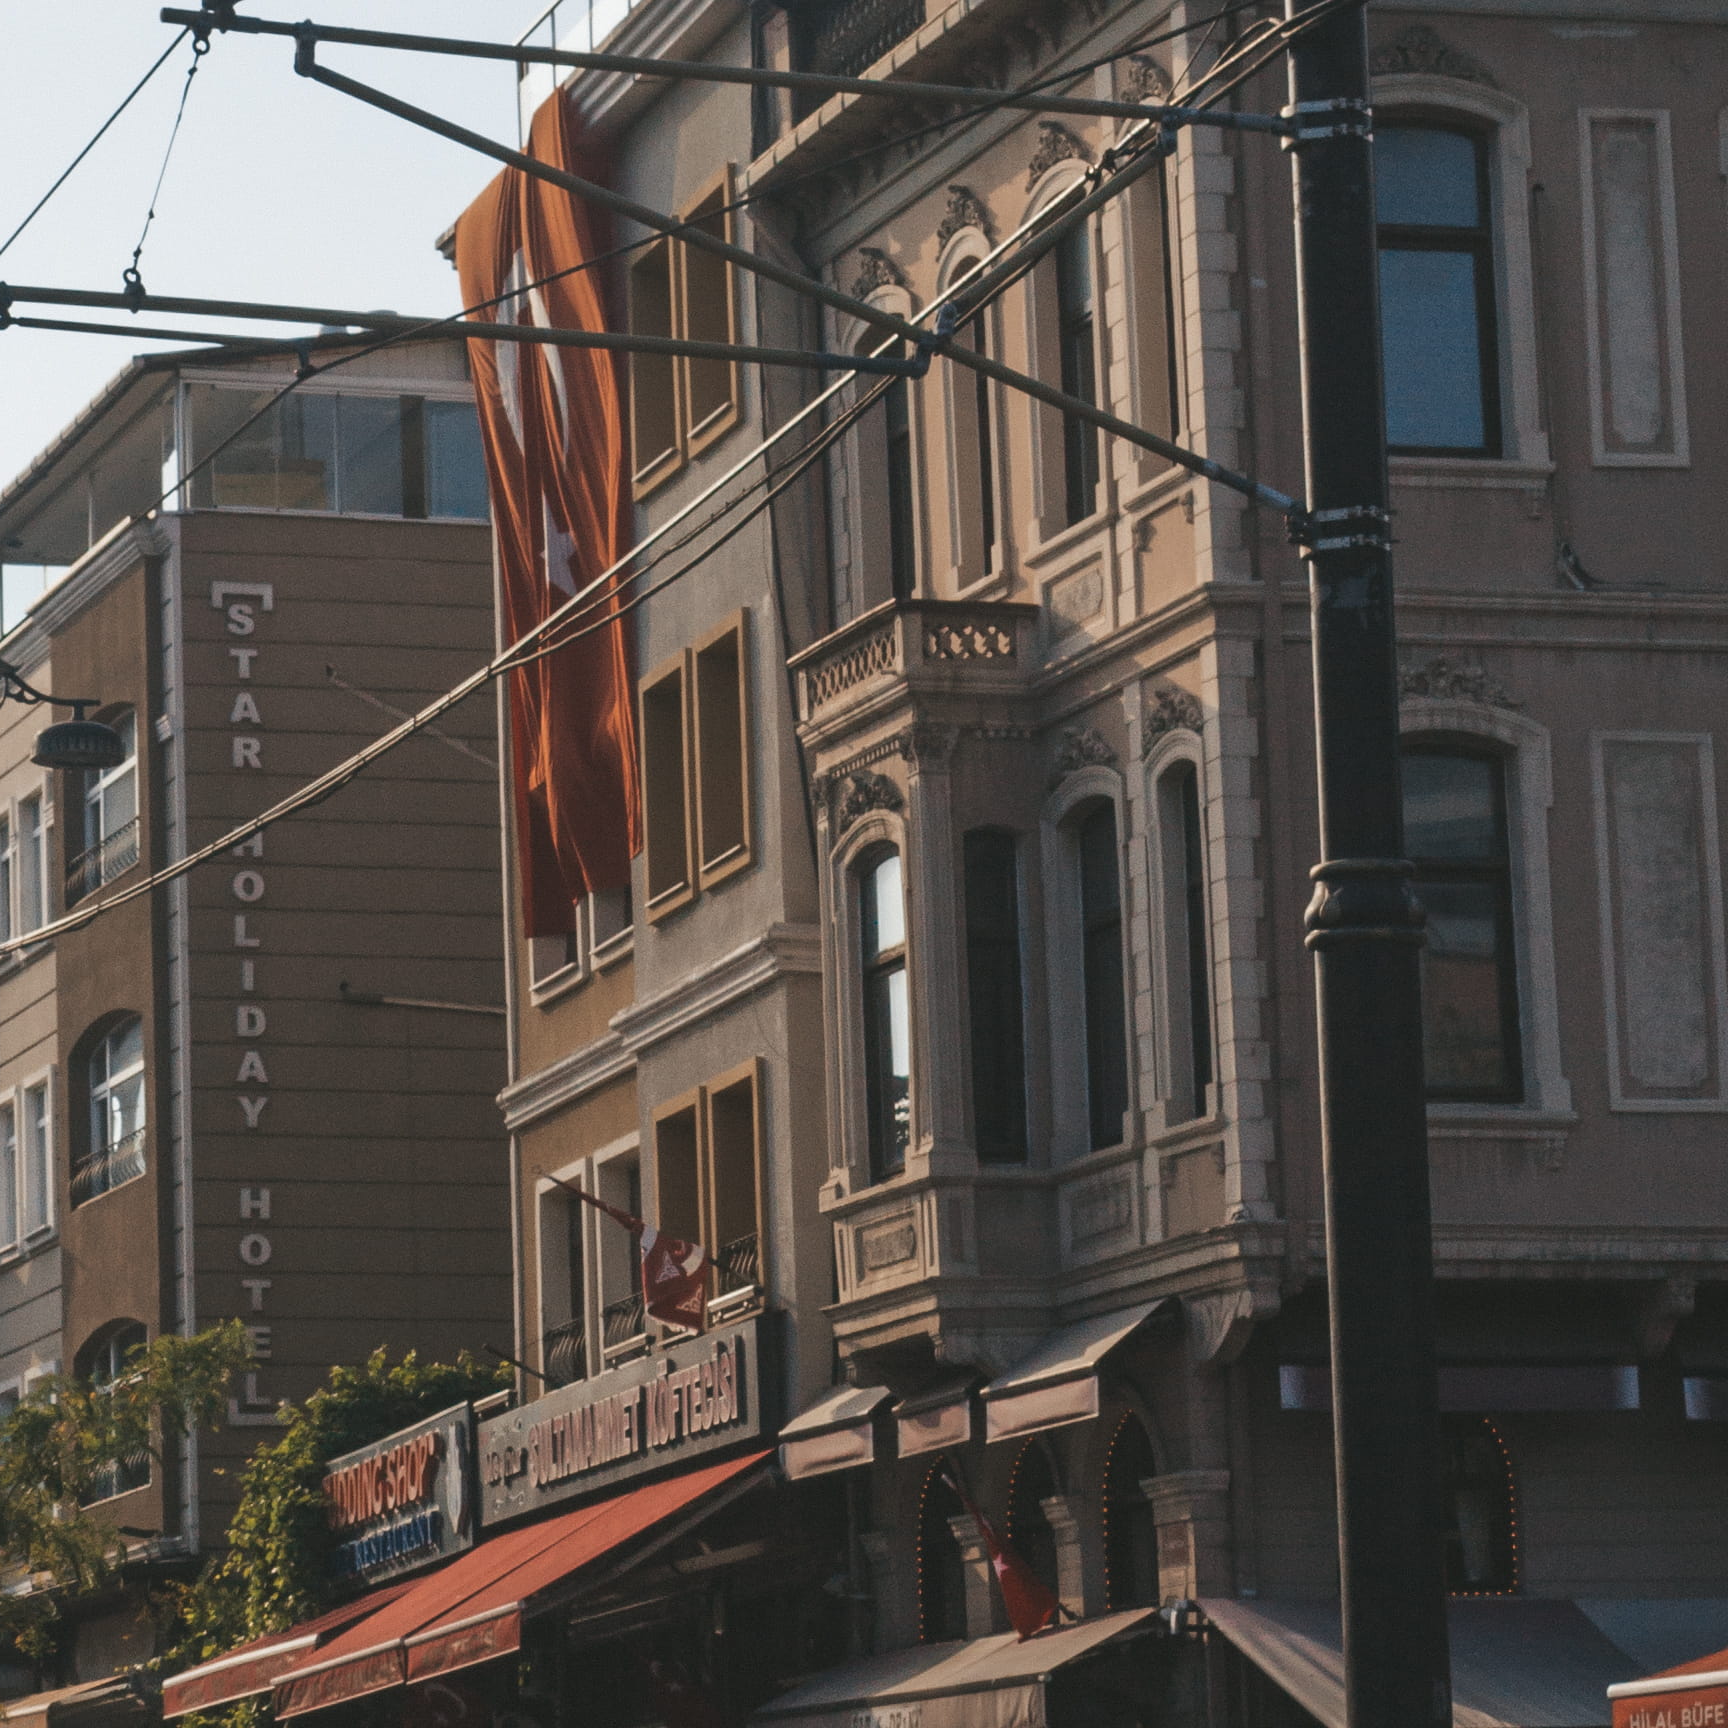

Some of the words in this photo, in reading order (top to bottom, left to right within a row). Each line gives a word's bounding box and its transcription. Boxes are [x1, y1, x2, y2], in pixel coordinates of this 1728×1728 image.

[227, 603, 262, 769] STAR
[232, 823, 269, 1129] HOLIDAY
[239, 1187, 272, 1405] HOTEL
[528, 1384, 641, 1489] SULTANAHMET
[1681, 1701, 1725, 1728] BÜFE
